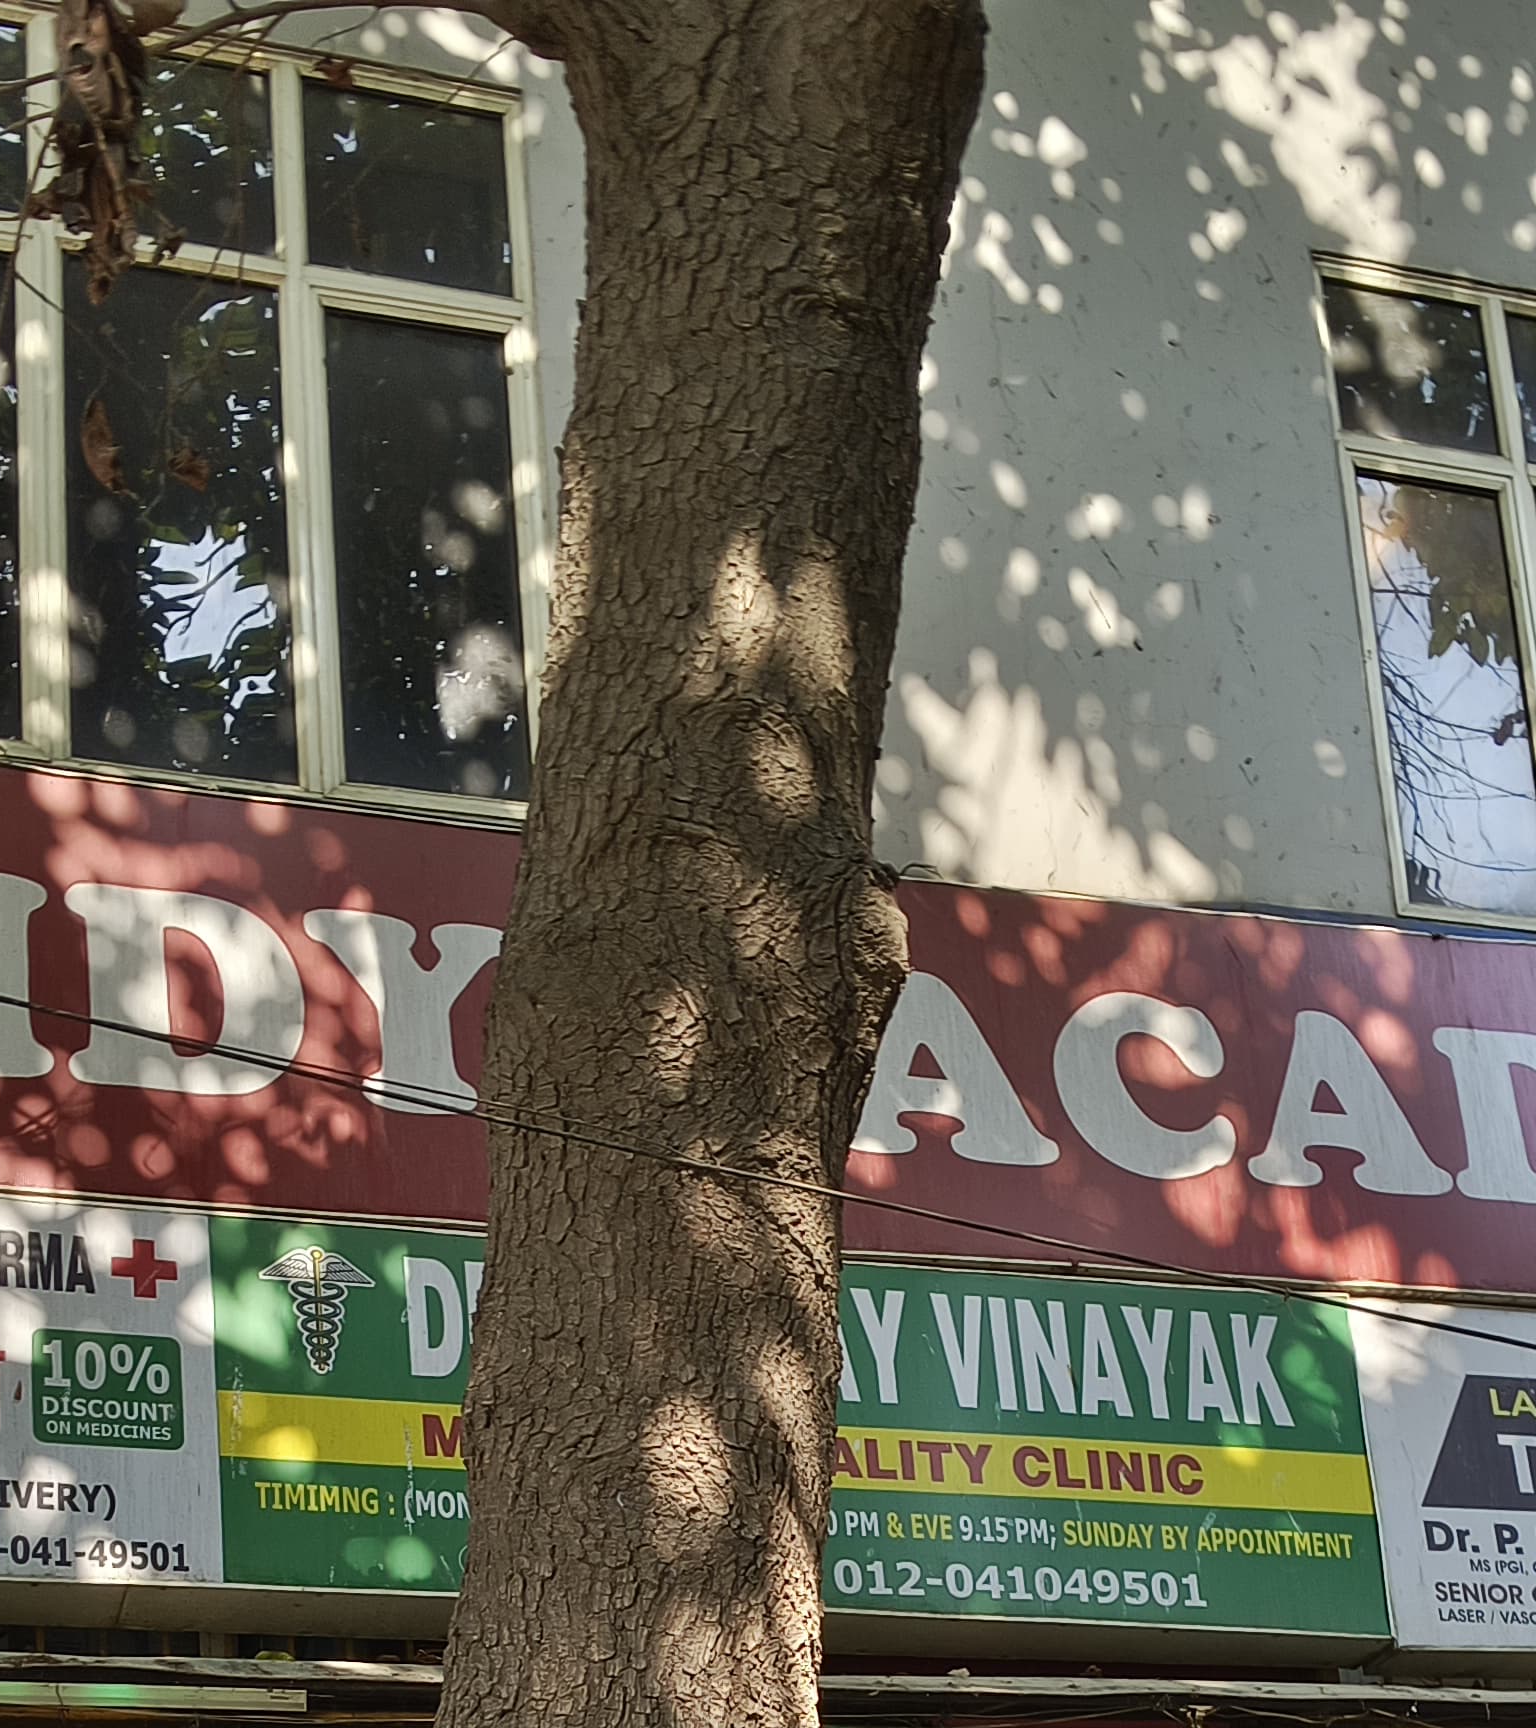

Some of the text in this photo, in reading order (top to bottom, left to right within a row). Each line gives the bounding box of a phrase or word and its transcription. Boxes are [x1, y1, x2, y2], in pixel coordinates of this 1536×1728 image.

[42, 1338, 171, 1397] 10%
[931, 1292, 1295, 1429] VINAYAK
[41, 1397, 174, 1424] DISCOUNT
[45, 1420, 172, 1442] ON MEDICINES
[1010, 1443, 1205, 1498] CLINIC
[254, 1480, 380, 1518] TIMIMNG
[1063, 1521, 1353, 1558] SUNDAY BY APPOINTMENT
[1424, 1520, 1480, 1553] Dr.
[1495, 1523, 1524, 1555] P.
[834, 1559, 1208, 1607] 012-041049501
[1435, 1581, 1524, 1603] SENIOR
[1438, 1608, 1486, 1624] LASER
